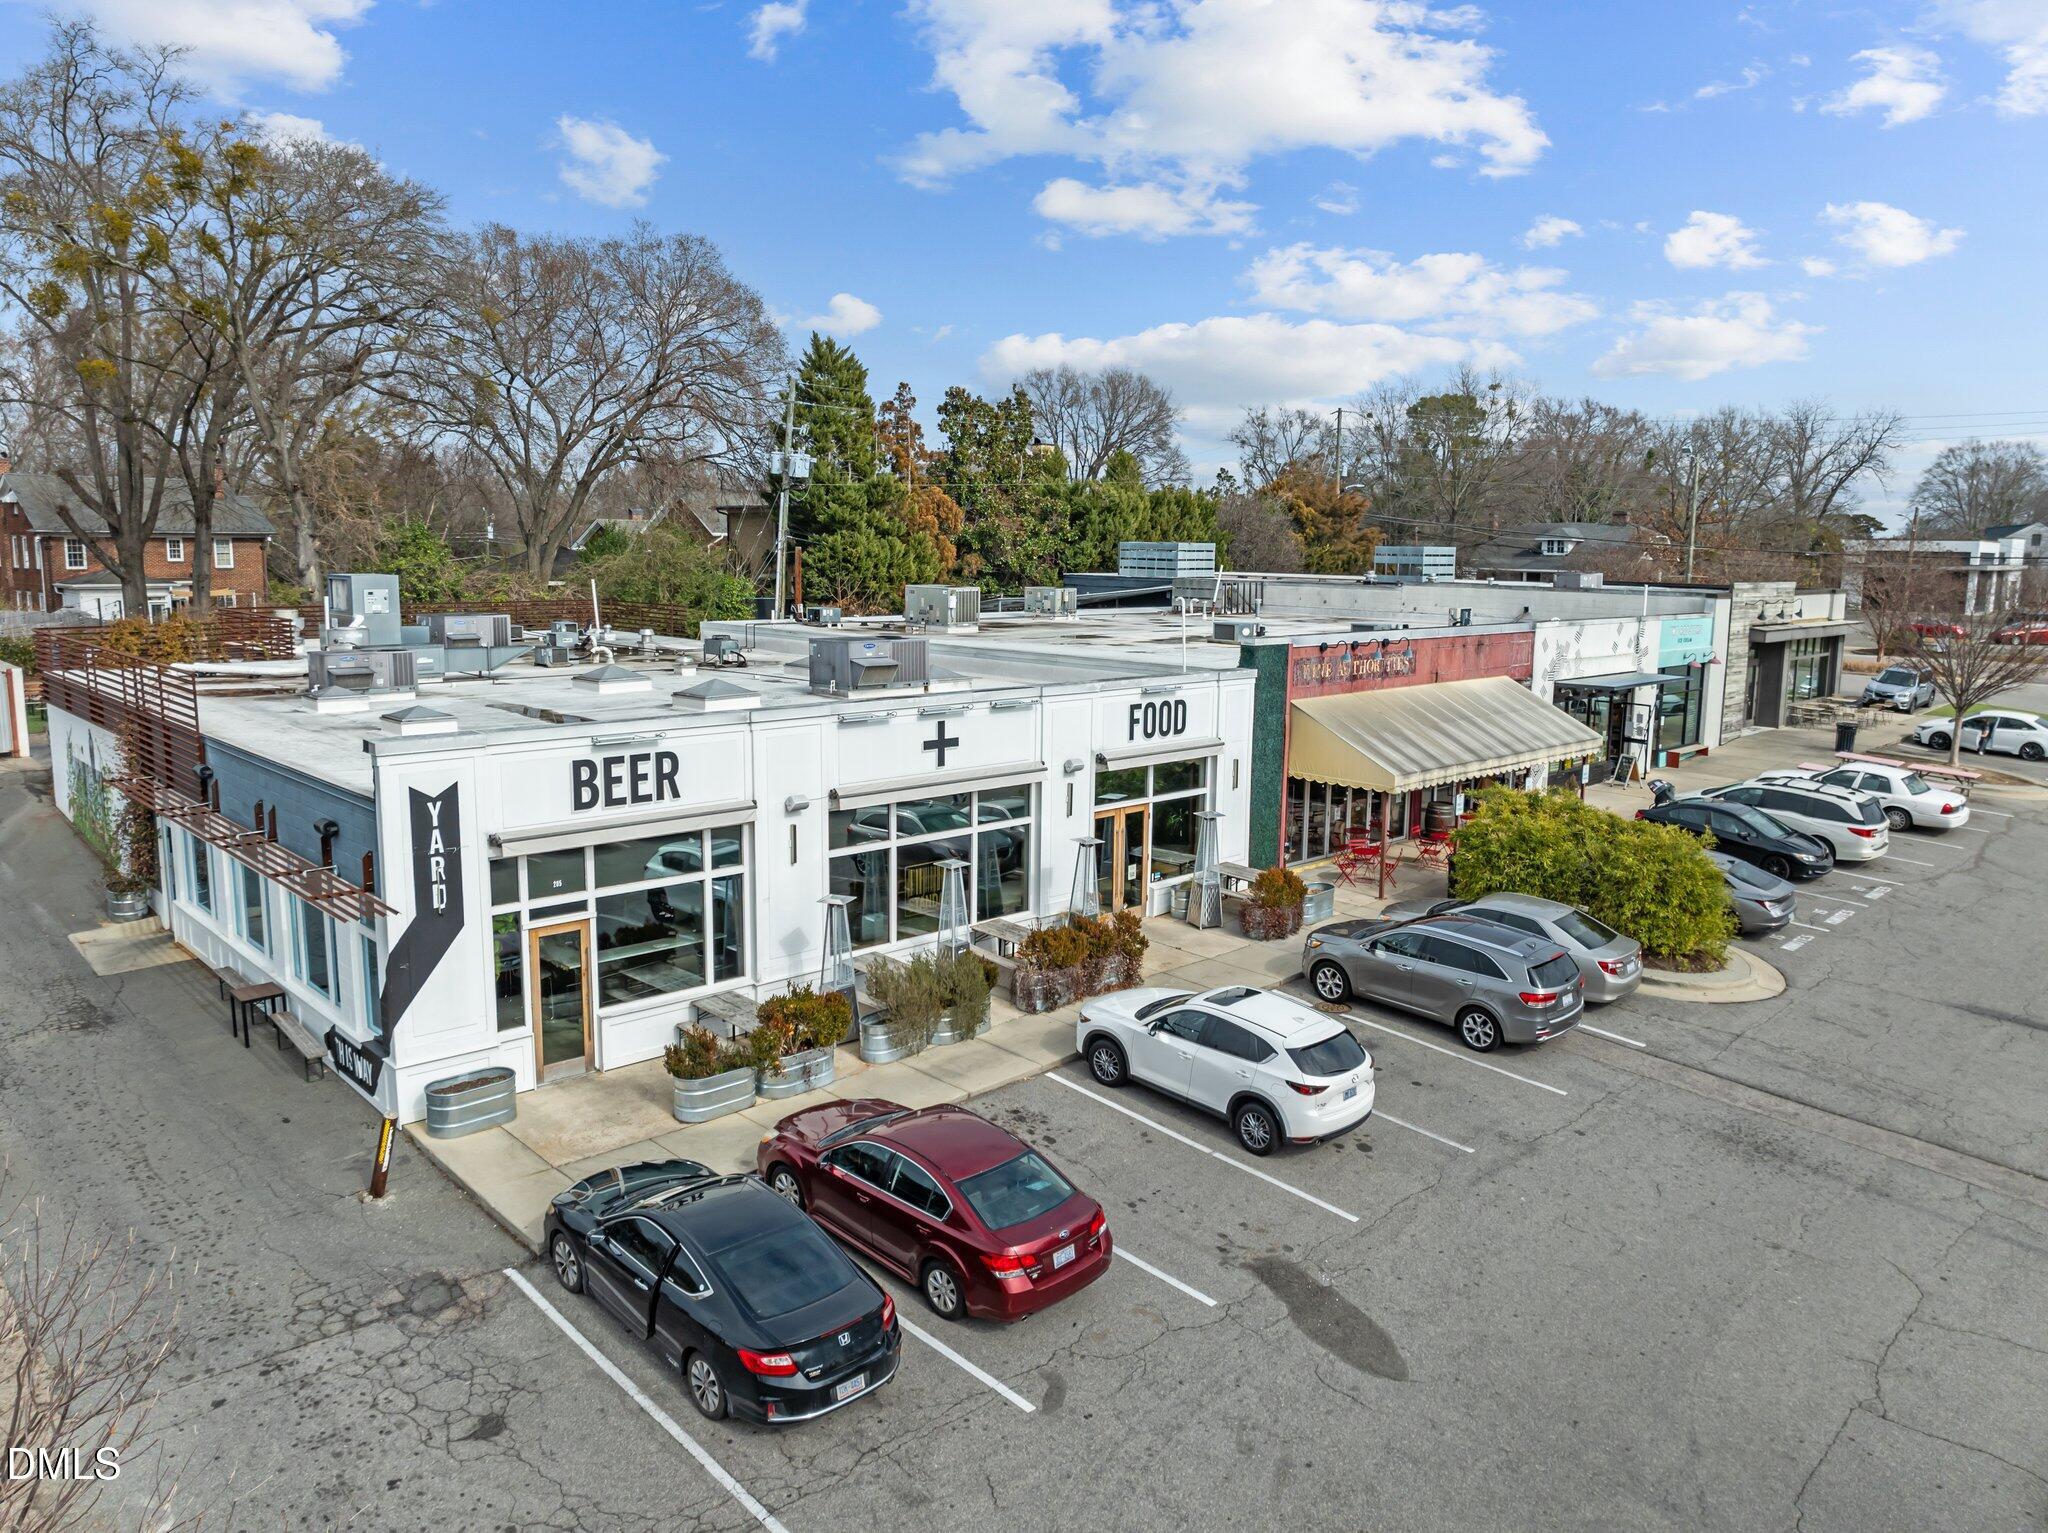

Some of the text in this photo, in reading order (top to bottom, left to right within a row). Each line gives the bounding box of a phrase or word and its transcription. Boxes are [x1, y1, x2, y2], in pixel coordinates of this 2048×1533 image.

[571, 751, 681, 812] BEER
[1129, 699, 1187, 741] FOOD
[427, 800, 447, 910] YARD
[353, 1051, 373, 1087] WAY
